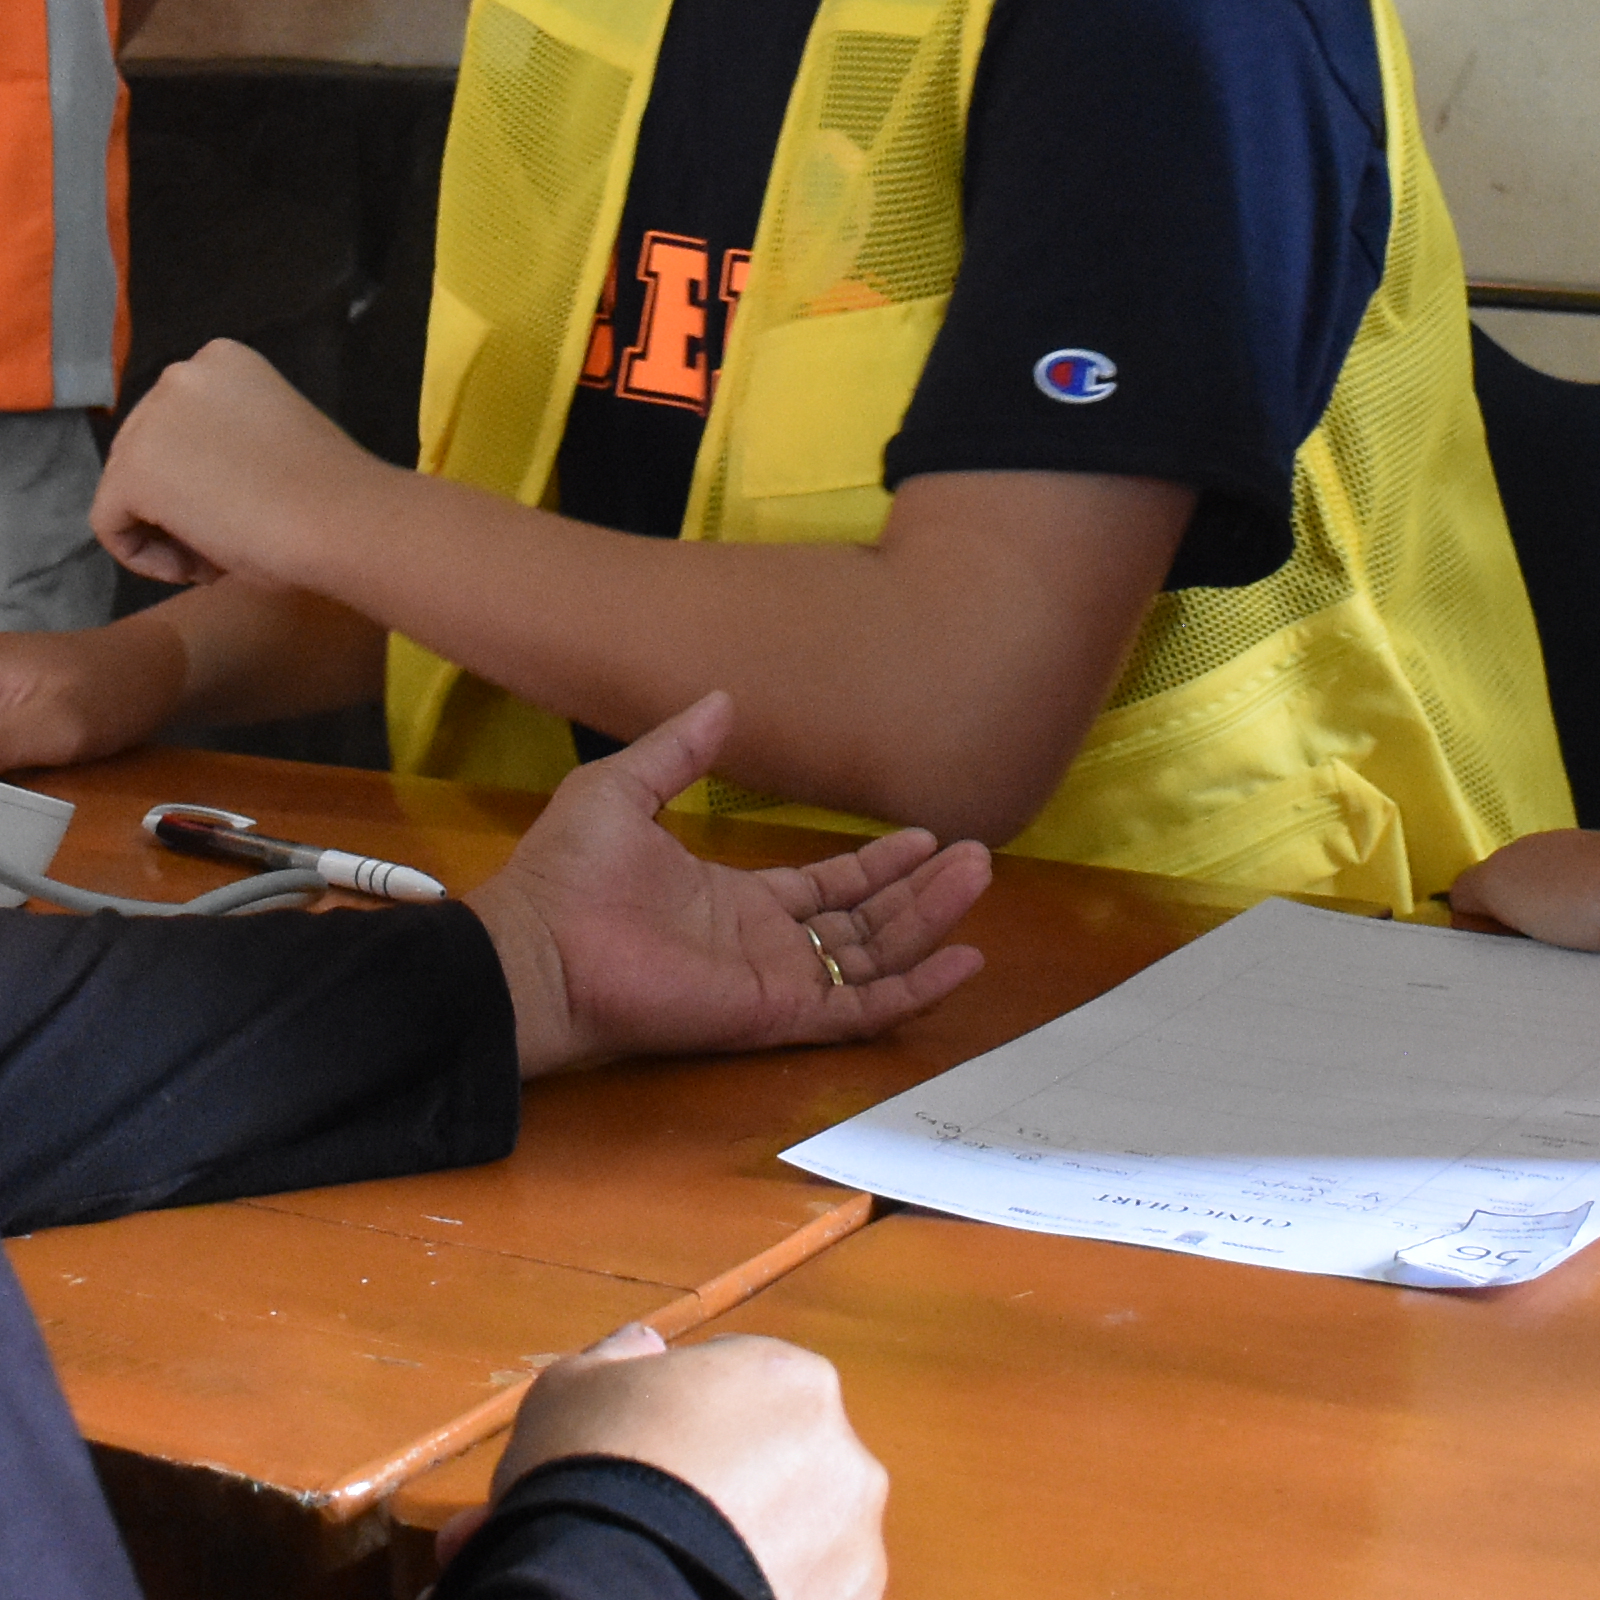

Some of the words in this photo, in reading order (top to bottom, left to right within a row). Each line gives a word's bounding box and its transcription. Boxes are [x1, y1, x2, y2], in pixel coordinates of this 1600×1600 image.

[1092, 1193, 1190, 1213] CHART
[1192, 1209, 1292, 1229] CLINIC
[1447, 1245, 1533, 1267] 56
